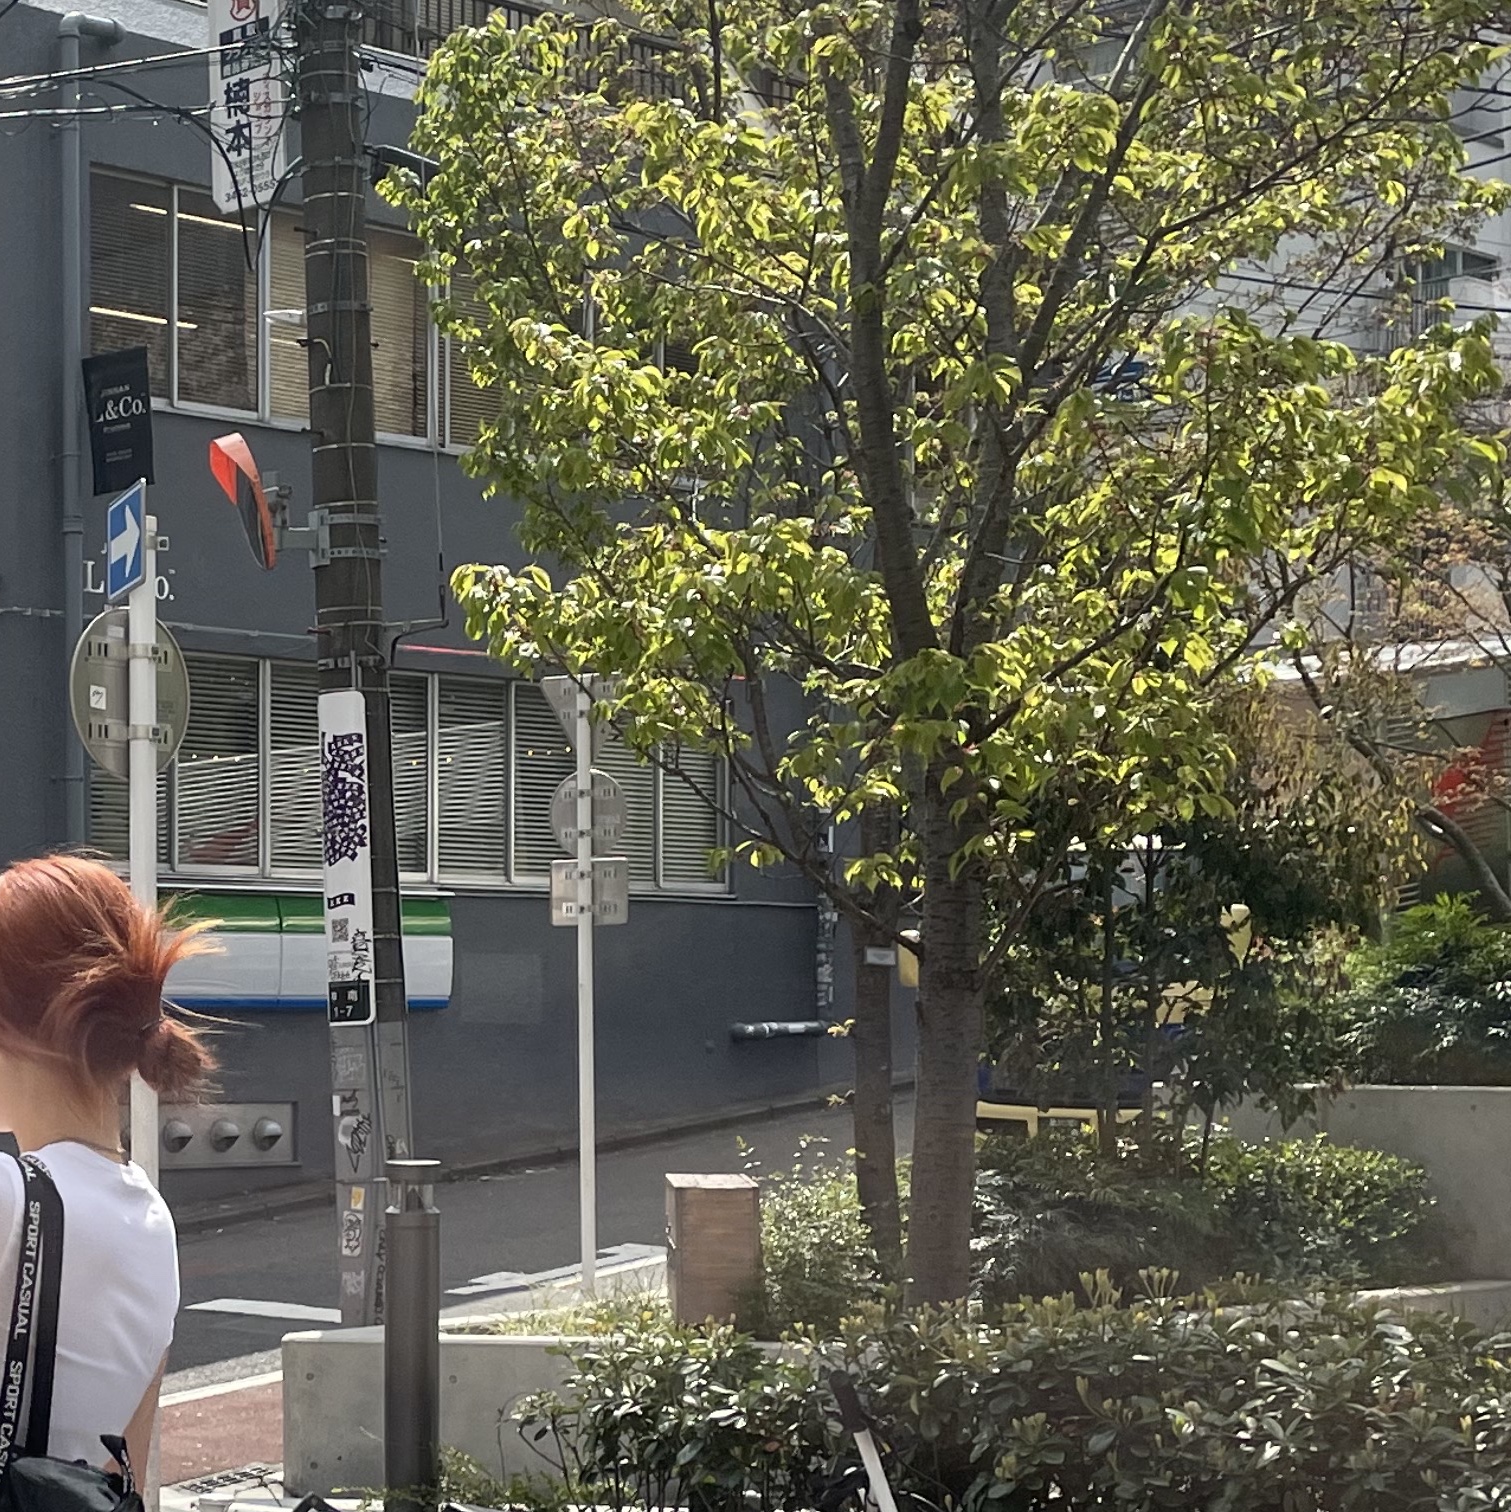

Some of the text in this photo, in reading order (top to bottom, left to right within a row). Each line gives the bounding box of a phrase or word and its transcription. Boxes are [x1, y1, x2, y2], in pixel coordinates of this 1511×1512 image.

[333, 1004, 354, 1018] 1-7
[25, 1200, 40, 1262] SPORT
[13, 1262, 35, 1340] CASUAL
[3, 1360, 23, 1423] SPORT
